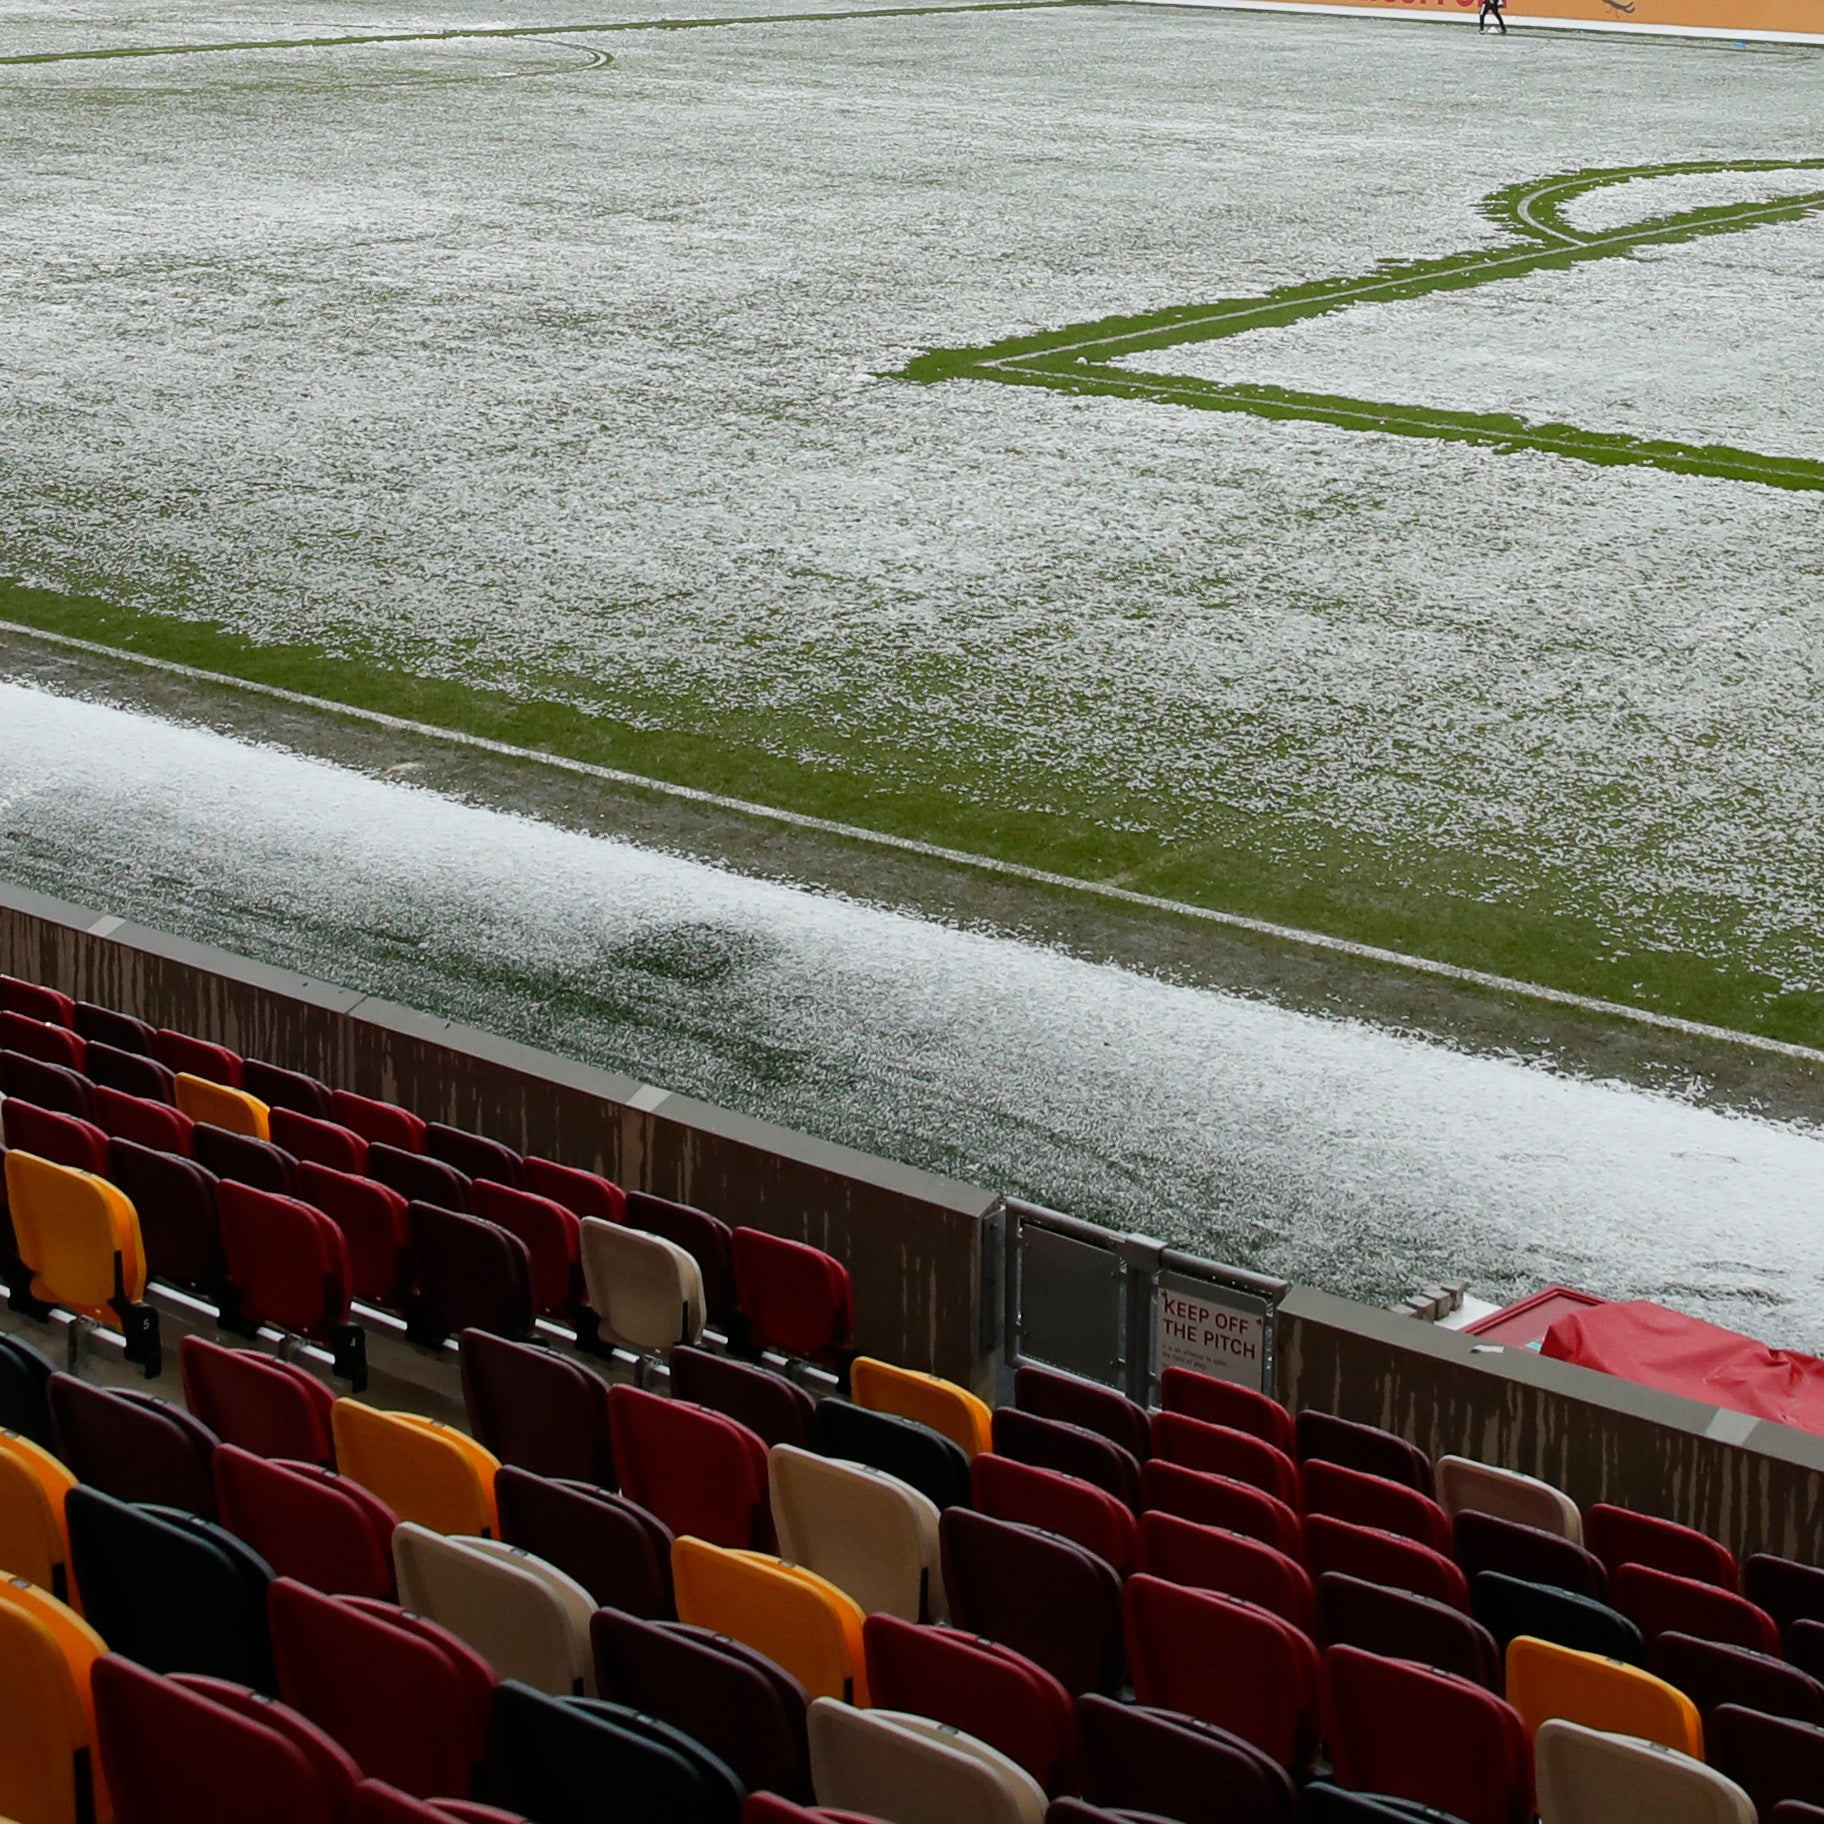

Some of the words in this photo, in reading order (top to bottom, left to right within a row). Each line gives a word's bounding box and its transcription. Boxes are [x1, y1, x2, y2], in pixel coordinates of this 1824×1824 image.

[143, 1318, 150, 1330] 5
[1164, 1297, 1210, 1323] KEEP
[1215, 1312, 1250, 1334] OFF
[1162, 1318, 1198, 1344] THE
[1203, 1330, 1256, 1360] PITCH
